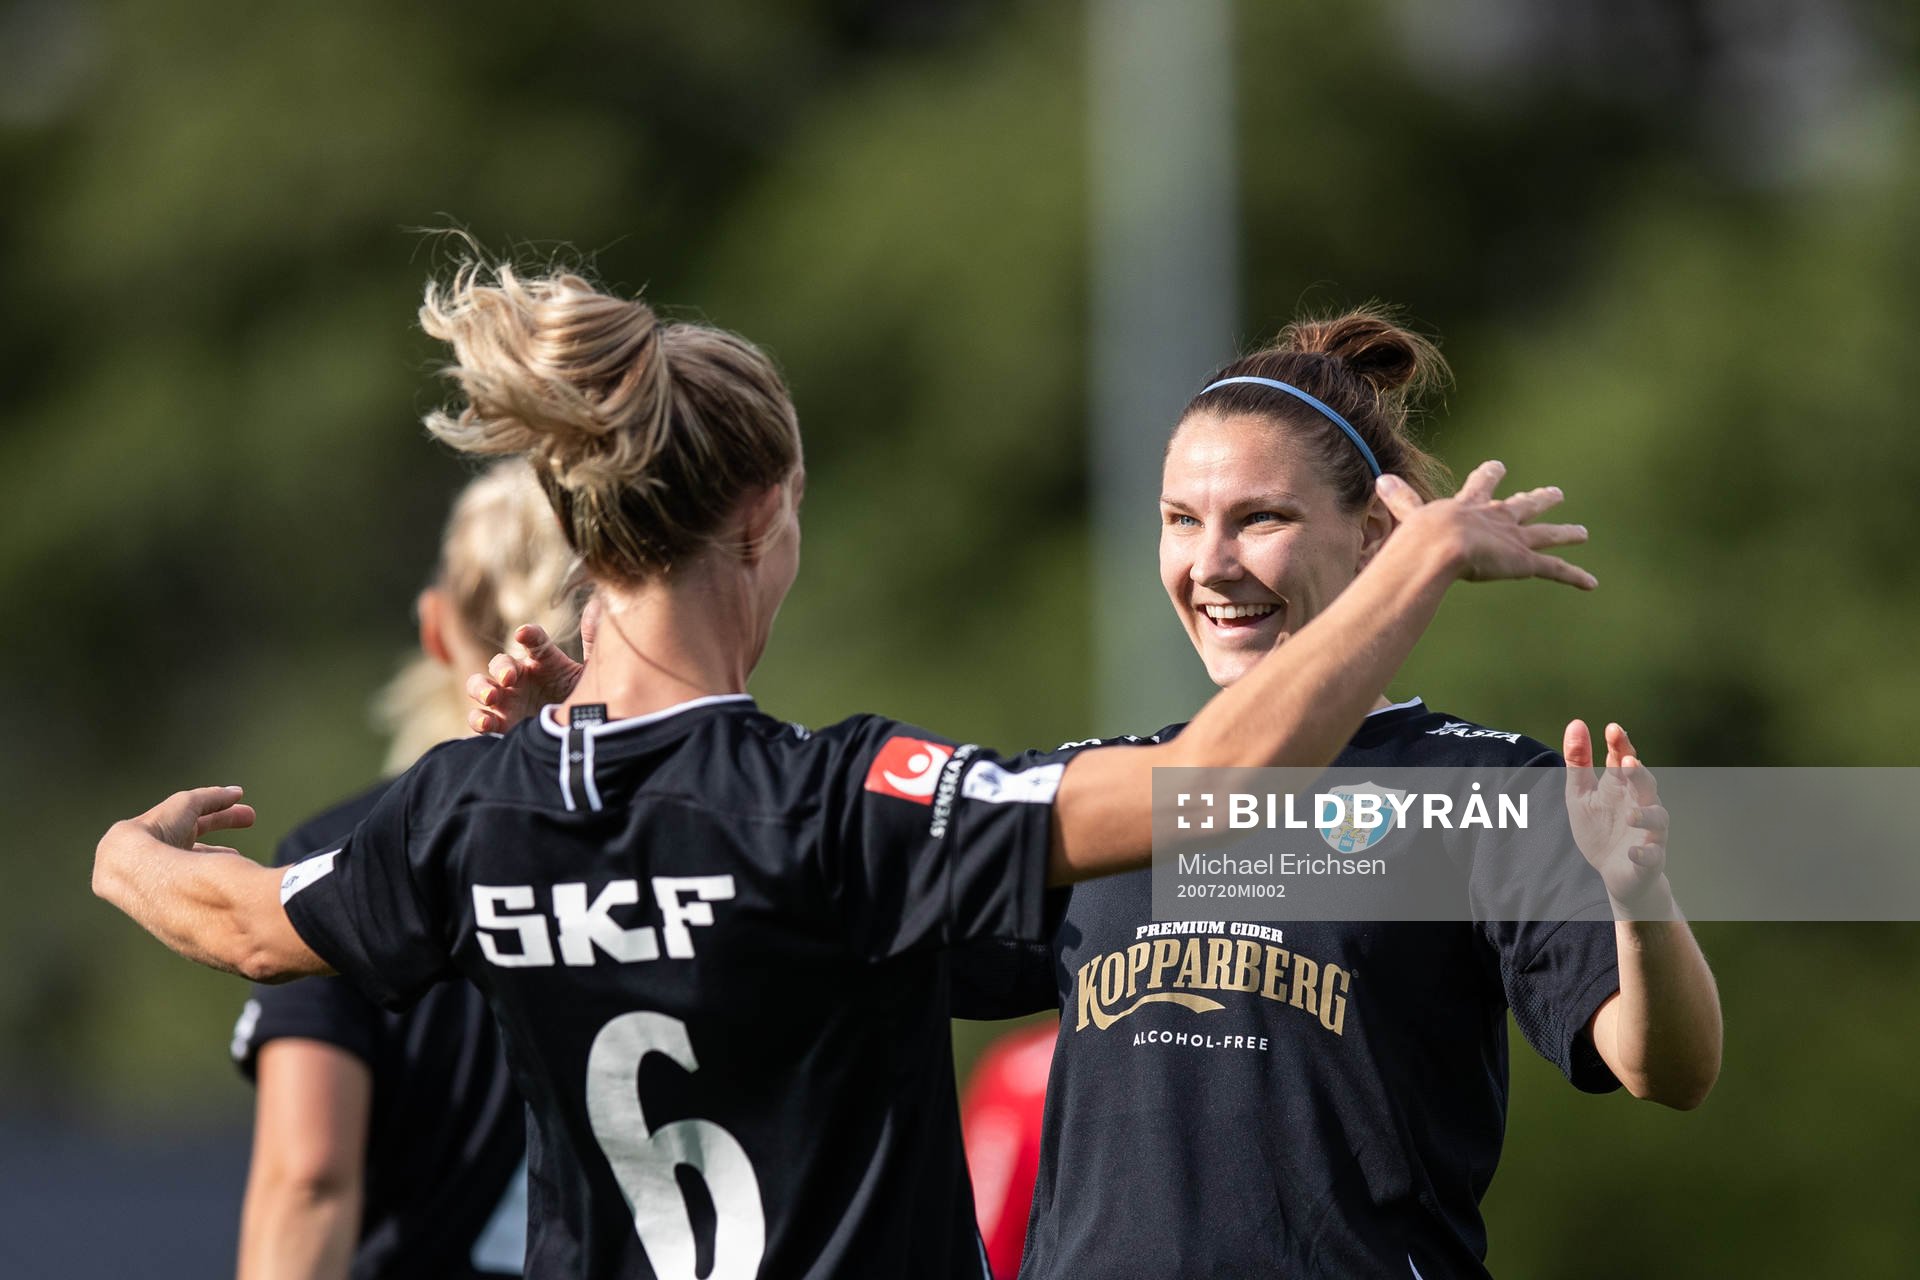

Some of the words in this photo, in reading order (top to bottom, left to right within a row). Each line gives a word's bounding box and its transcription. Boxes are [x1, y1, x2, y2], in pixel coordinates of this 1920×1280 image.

[472, 874, 736, 968] SKF
[1135, 920, 1226, 940] PREMIUM
[1230, 921, 1284, 944] CIDER
[1075, 937, 1351, 1036] KOPPARBERG
[1132, 1029, 1269, 1051] ALCOHOL-FREE
[586, 1010, 766, 1280] 6
